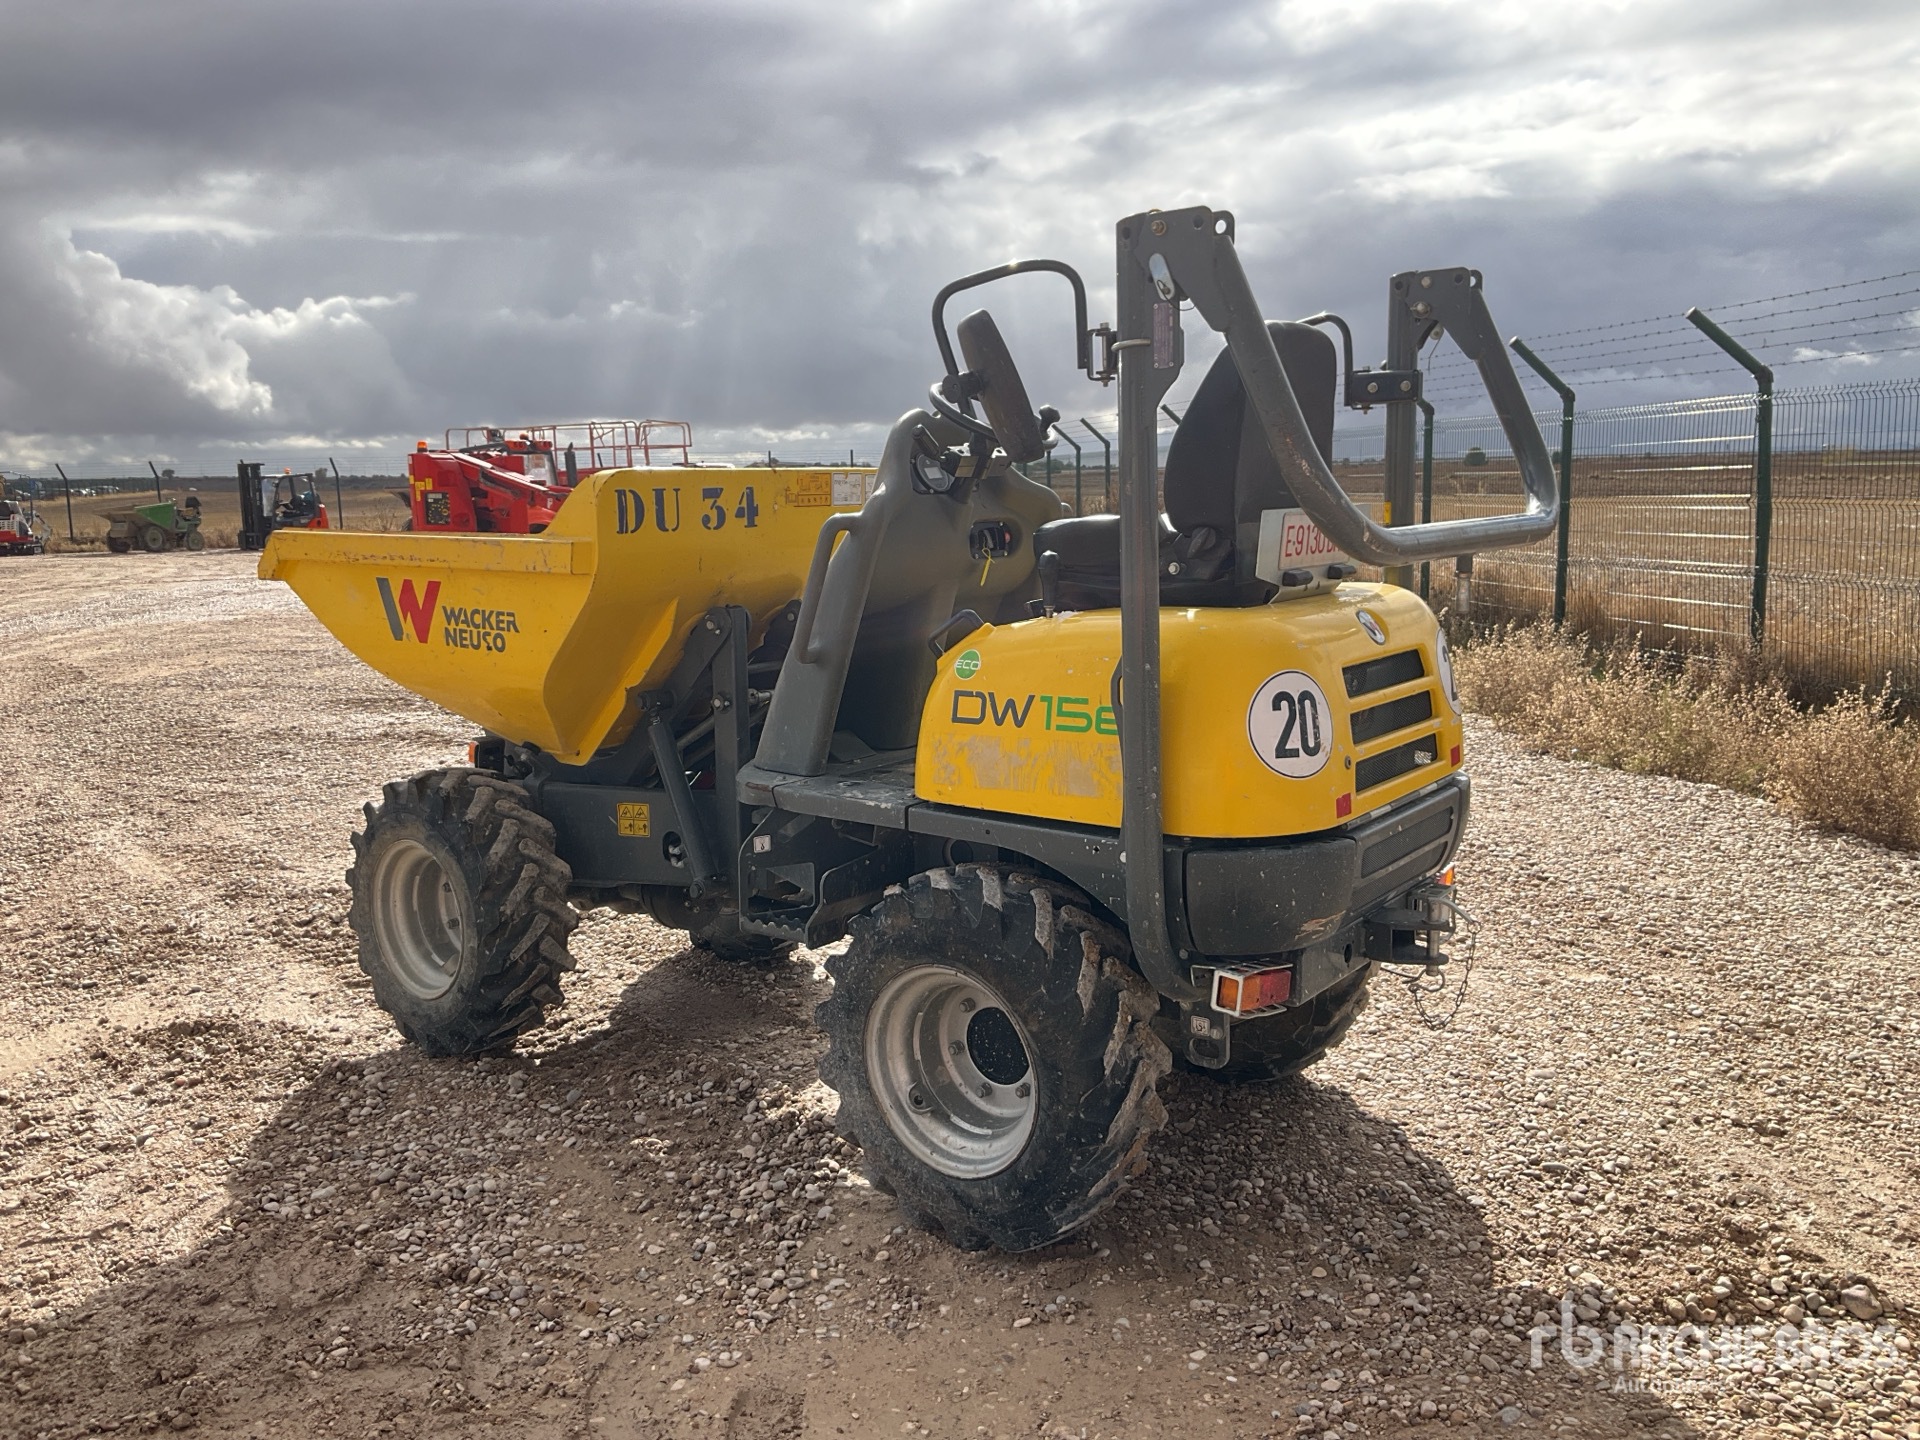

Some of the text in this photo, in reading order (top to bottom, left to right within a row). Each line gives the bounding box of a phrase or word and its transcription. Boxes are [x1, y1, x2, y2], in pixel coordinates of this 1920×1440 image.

[614, 488, 681, 534] DU
[701, 486, 759, 531] 34
[442, 605, 520, 633] WACKER
[955, 659, 981, 671] ECO
[1271, 689, 1321, 759] 20
